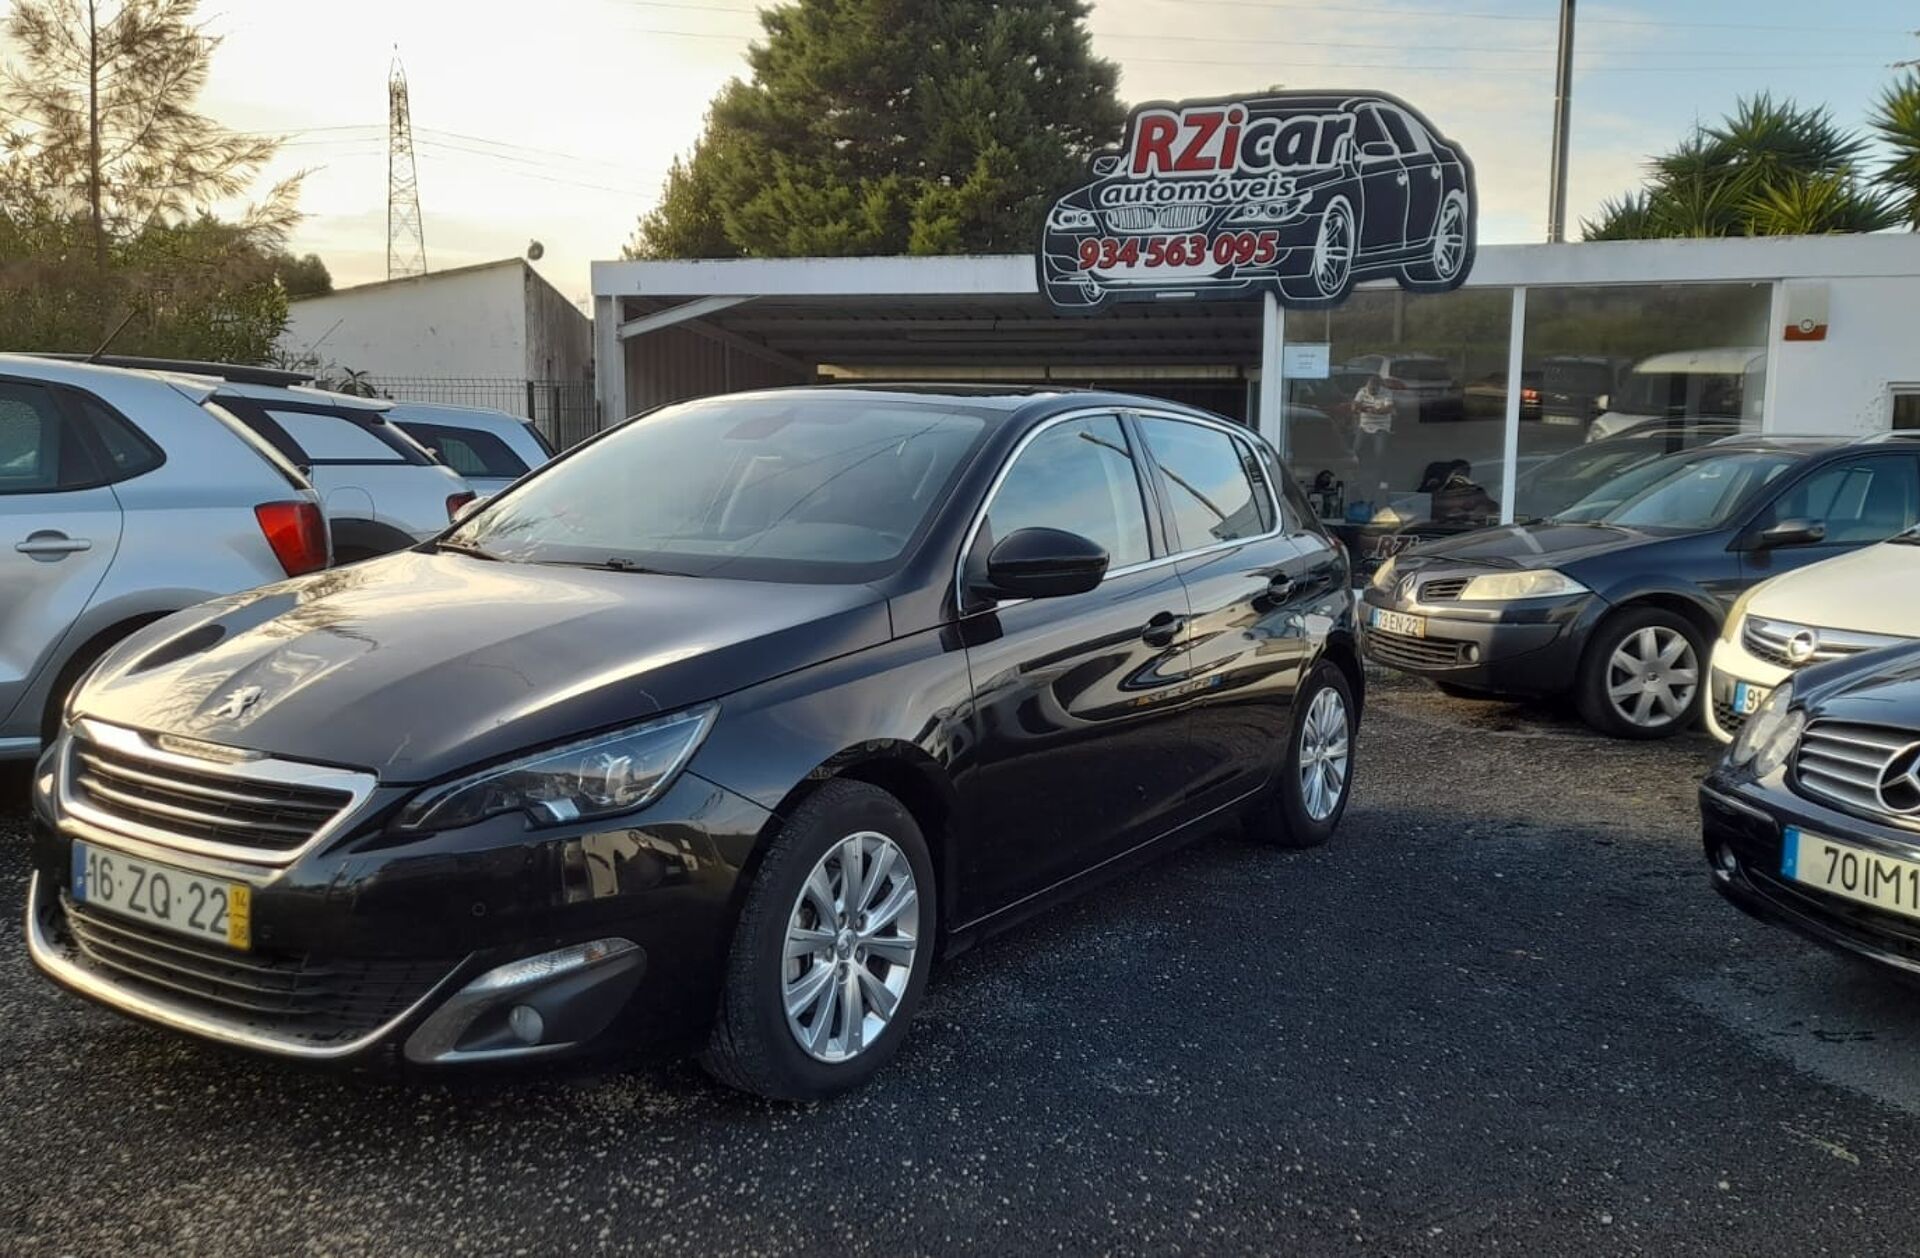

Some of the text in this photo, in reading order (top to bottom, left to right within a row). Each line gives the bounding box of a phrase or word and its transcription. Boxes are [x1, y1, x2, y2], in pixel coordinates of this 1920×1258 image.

[1131, 106, 1353, 175] RZicar
[1103, 174, 1296, 204] automóveis
[1079, 231, 1279, 270] 934 563 095
